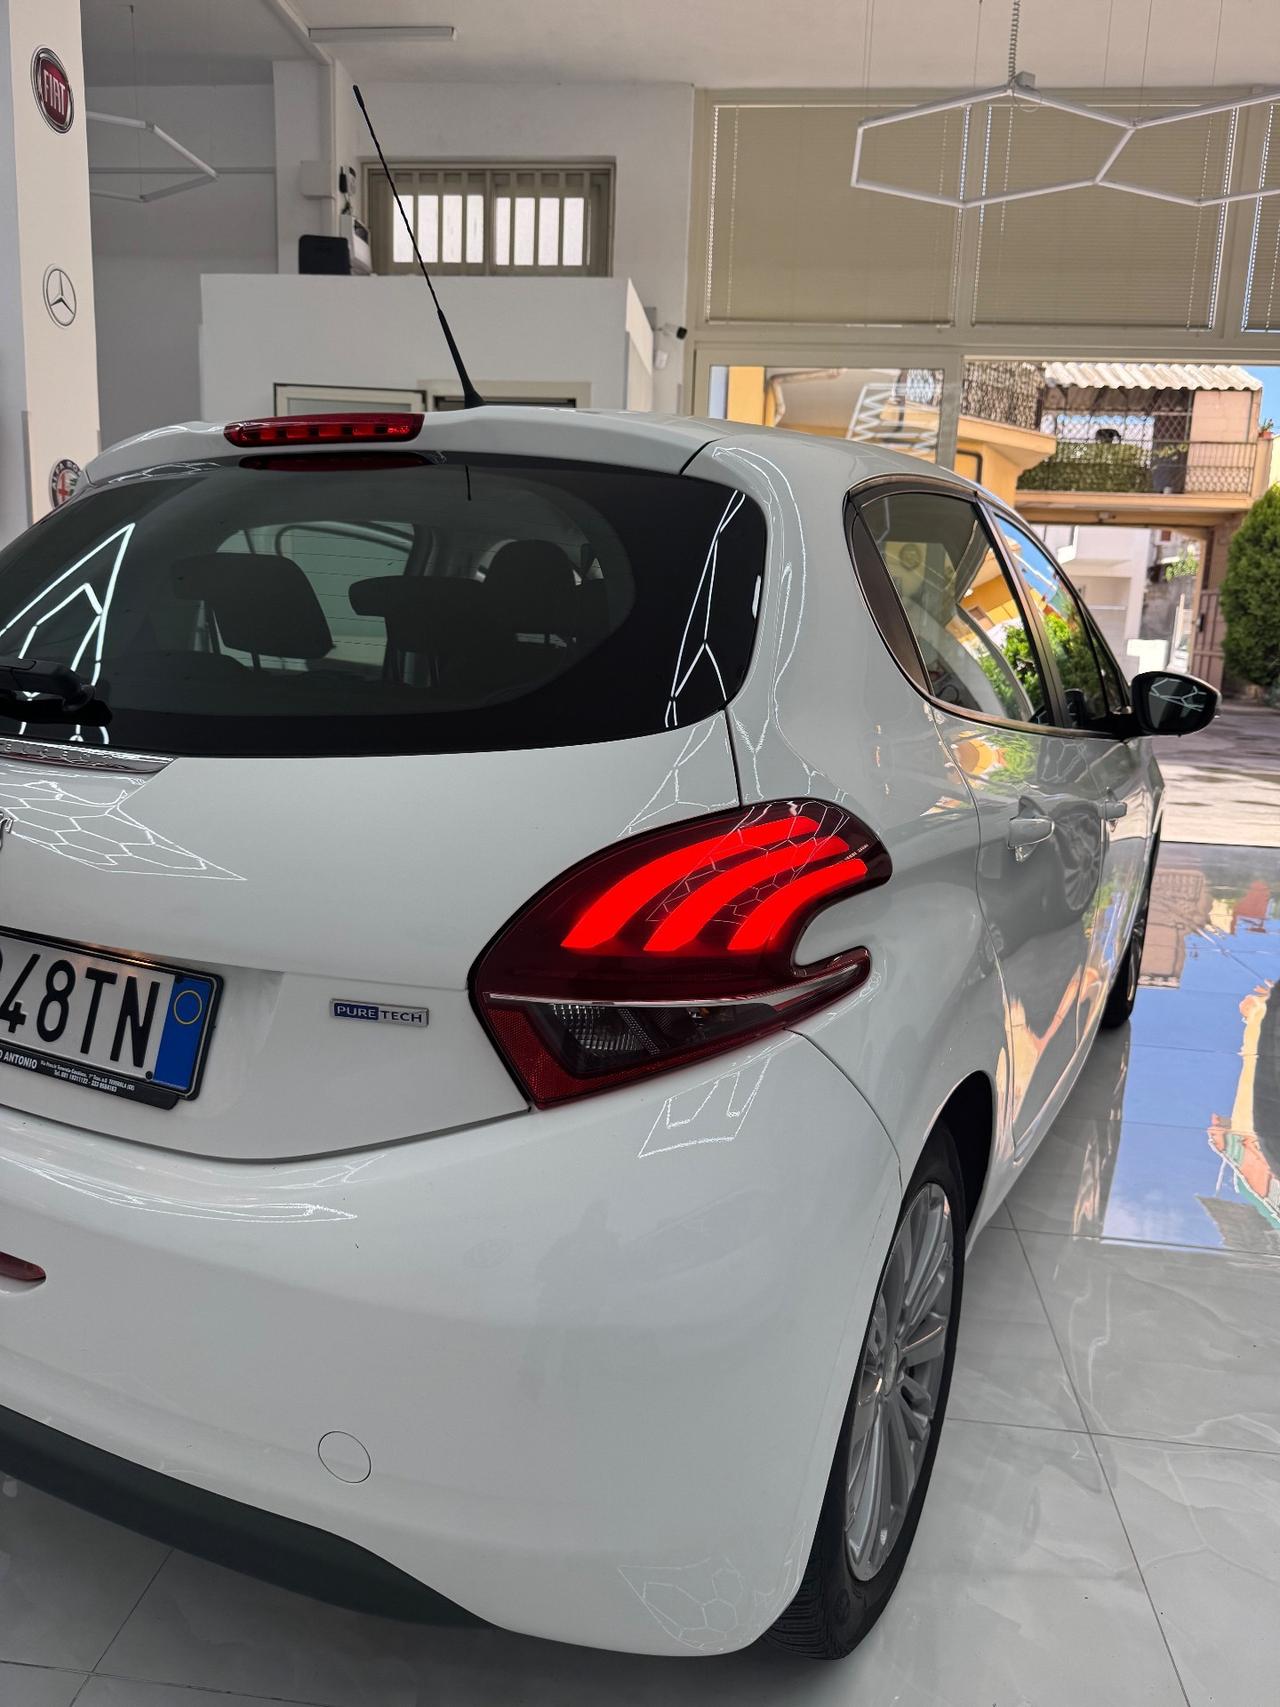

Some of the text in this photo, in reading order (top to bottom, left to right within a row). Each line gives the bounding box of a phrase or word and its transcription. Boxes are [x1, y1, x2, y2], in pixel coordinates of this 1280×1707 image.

[43, 69, 66, 115] FIAT
[0, 947, 160, 1068] 48TN
[3, 1051, 38, 1069] ANTONIO
